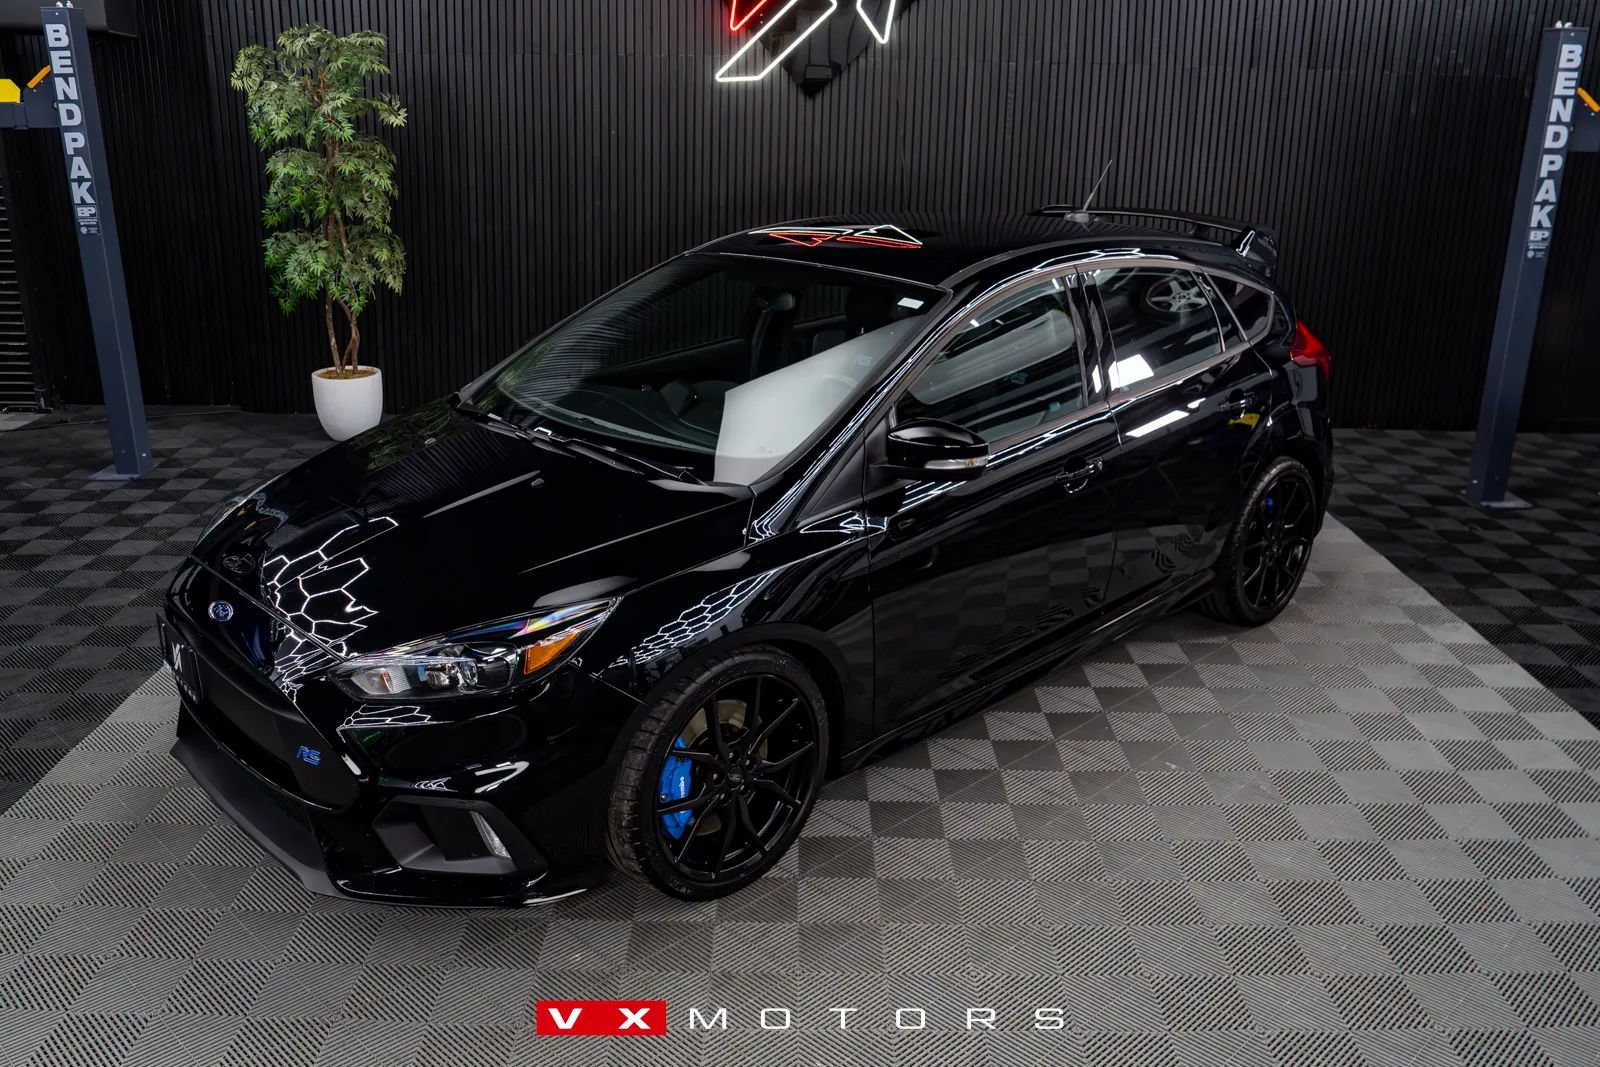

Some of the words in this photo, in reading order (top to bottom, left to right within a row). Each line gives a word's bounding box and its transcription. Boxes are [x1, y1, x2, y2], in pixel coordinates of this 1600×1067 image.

[45, 24, 96, 204] BENDPAK
[1530, 44, 1583, 228] BENDPAK
[77, 206, 96, 217] BP
[1529, 230, 1549, 241] BP
[296, 745, 321, 765] RS
